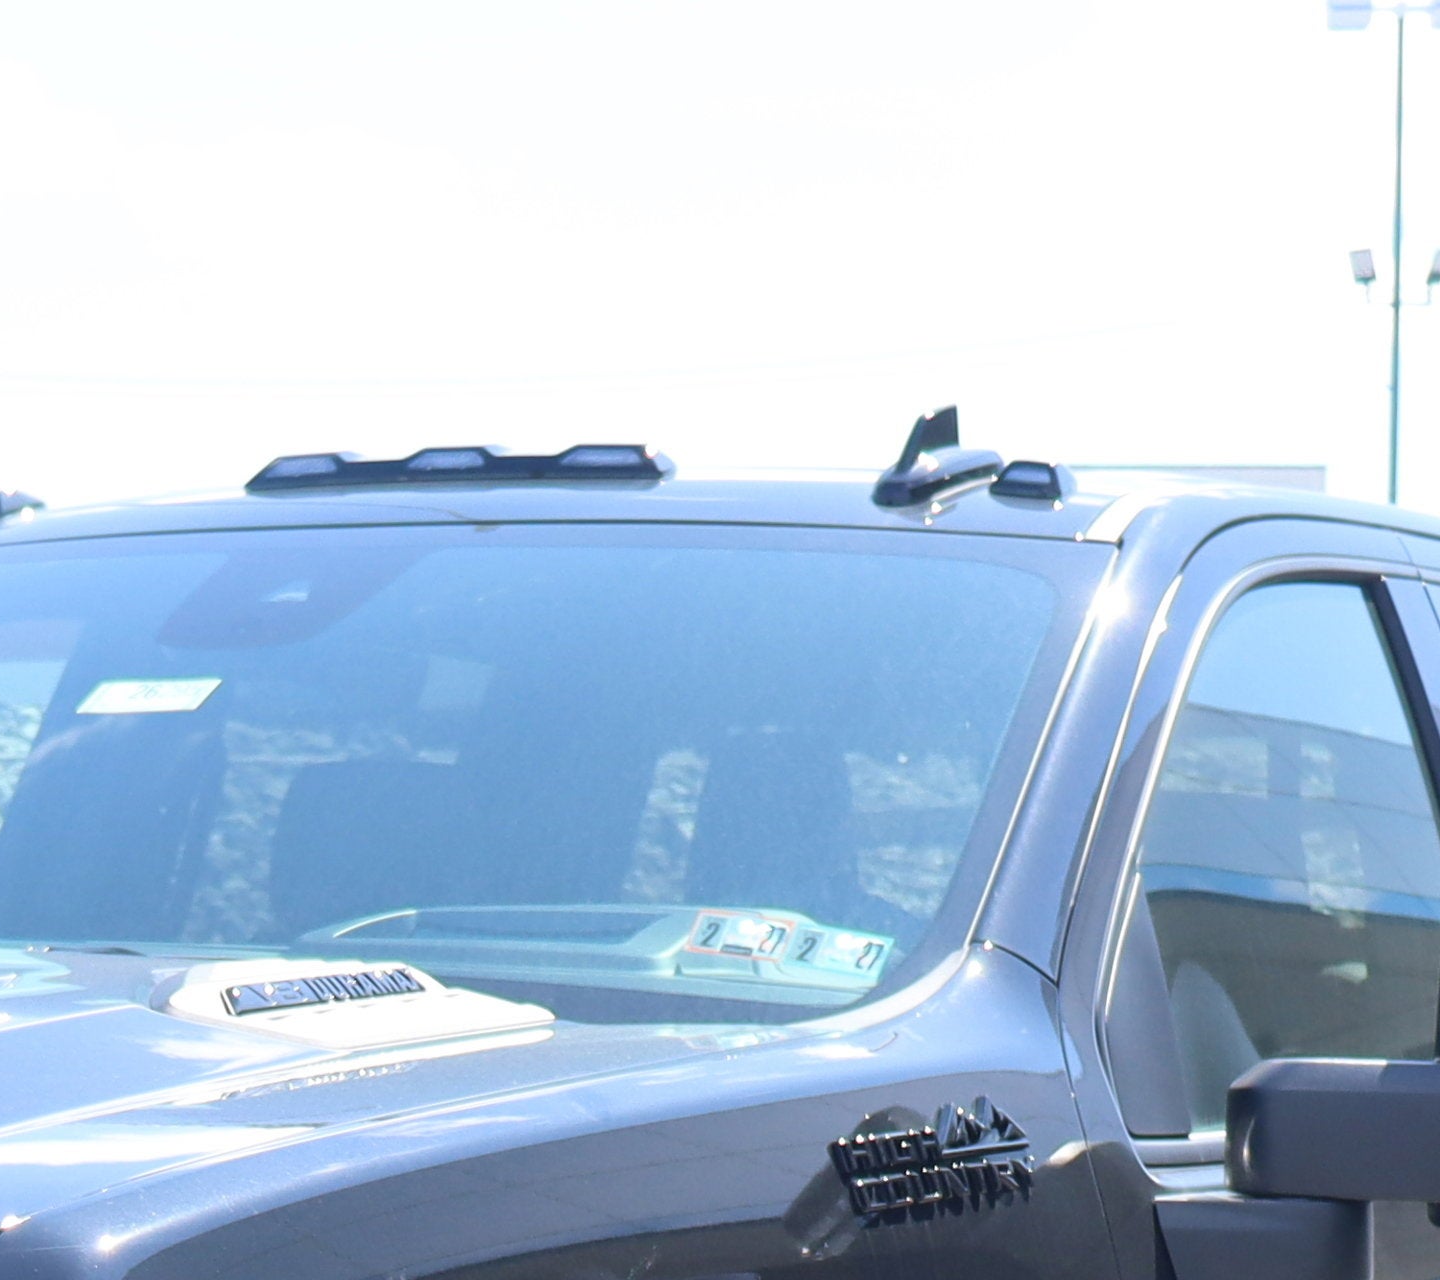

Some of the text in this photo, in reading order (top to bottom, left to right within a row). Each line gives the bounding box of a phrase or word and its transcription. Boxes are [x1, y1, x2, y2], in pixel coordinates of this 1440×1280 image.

[702, 922, 721, 947] 2
[759, 925, 787, 955] 27
[795, 936, 818, 961] 2
[856, 941, 885, 969] 27
[828, 1127, 942, 1180] HIGH
[850, 1155, 1034, 1216] COUNTRY
